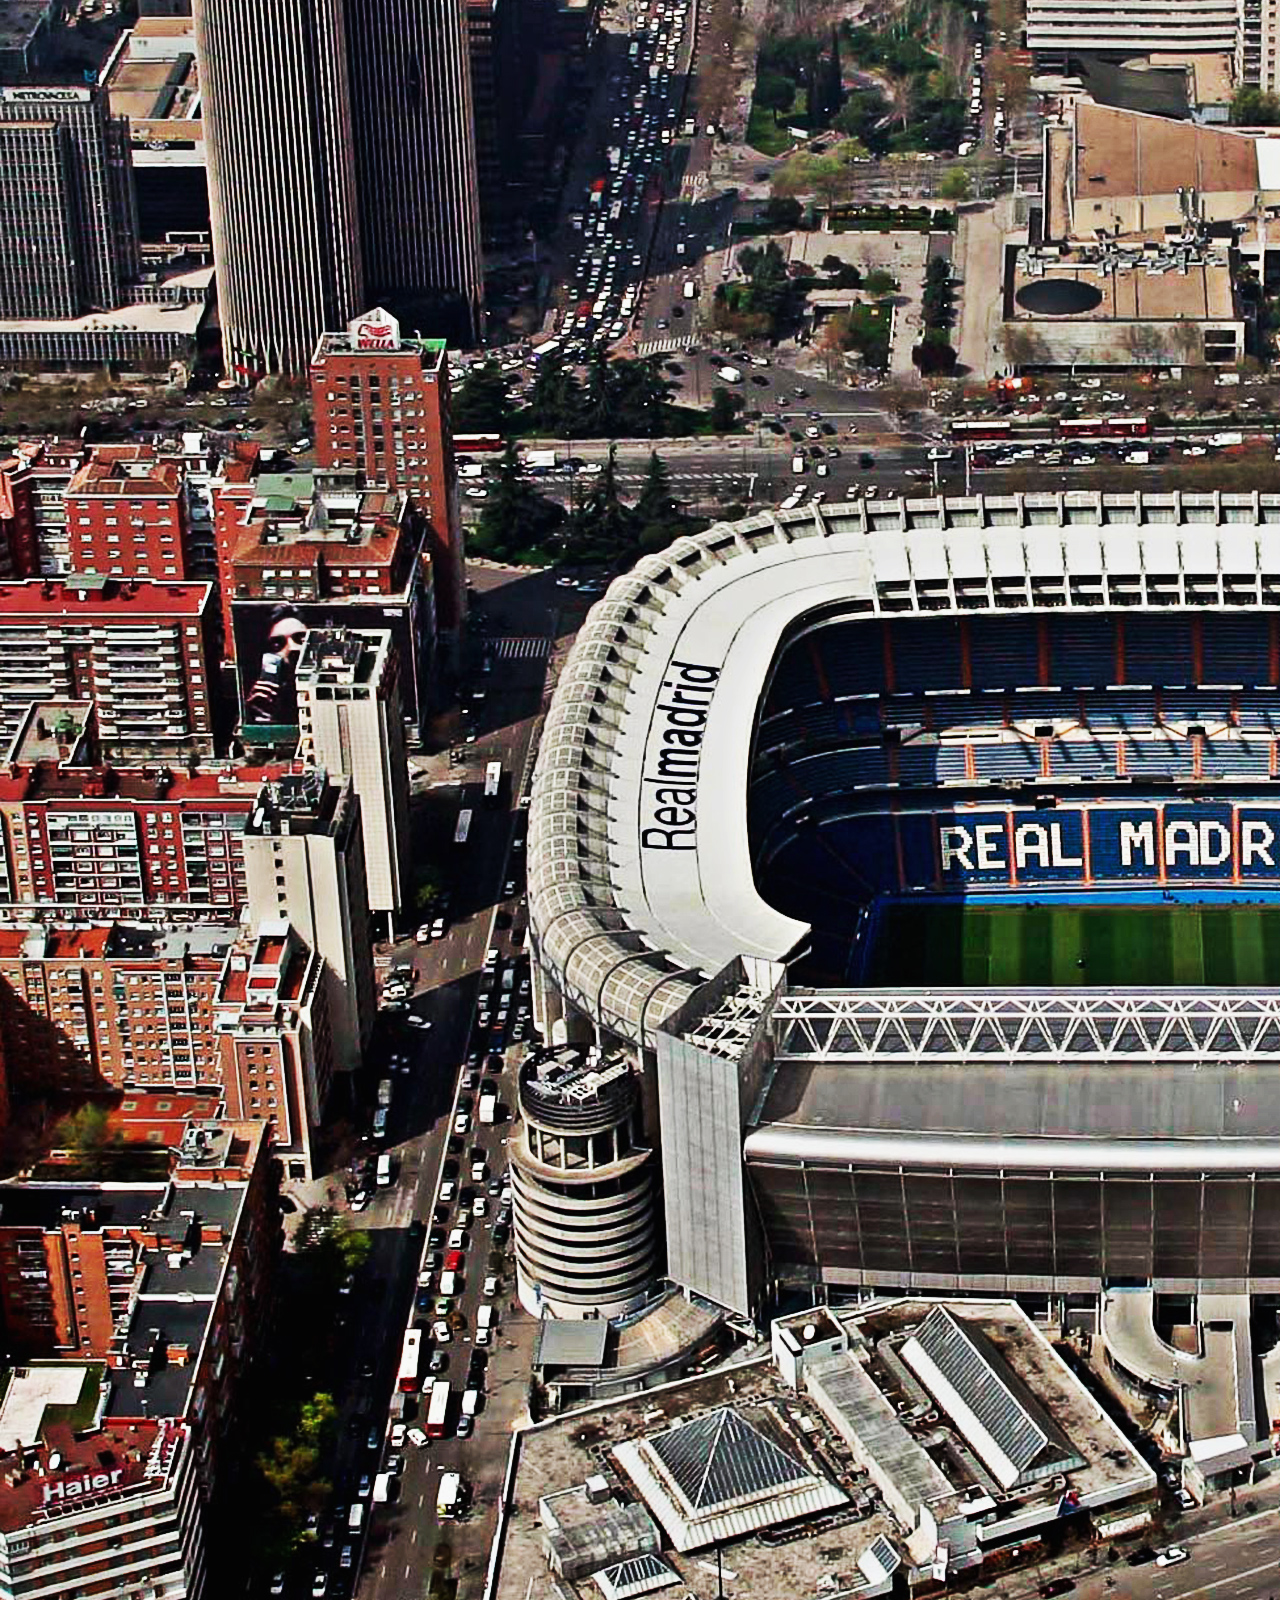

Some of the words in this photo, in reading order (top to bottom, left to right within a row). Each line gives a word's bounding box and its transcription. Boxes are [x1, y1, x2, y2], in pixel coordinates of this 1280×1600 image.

[357, 339, 394, 349] WELLA
[940, 822, 1082, 870] REAL
[42, 1469, 122, 1502] Haier
